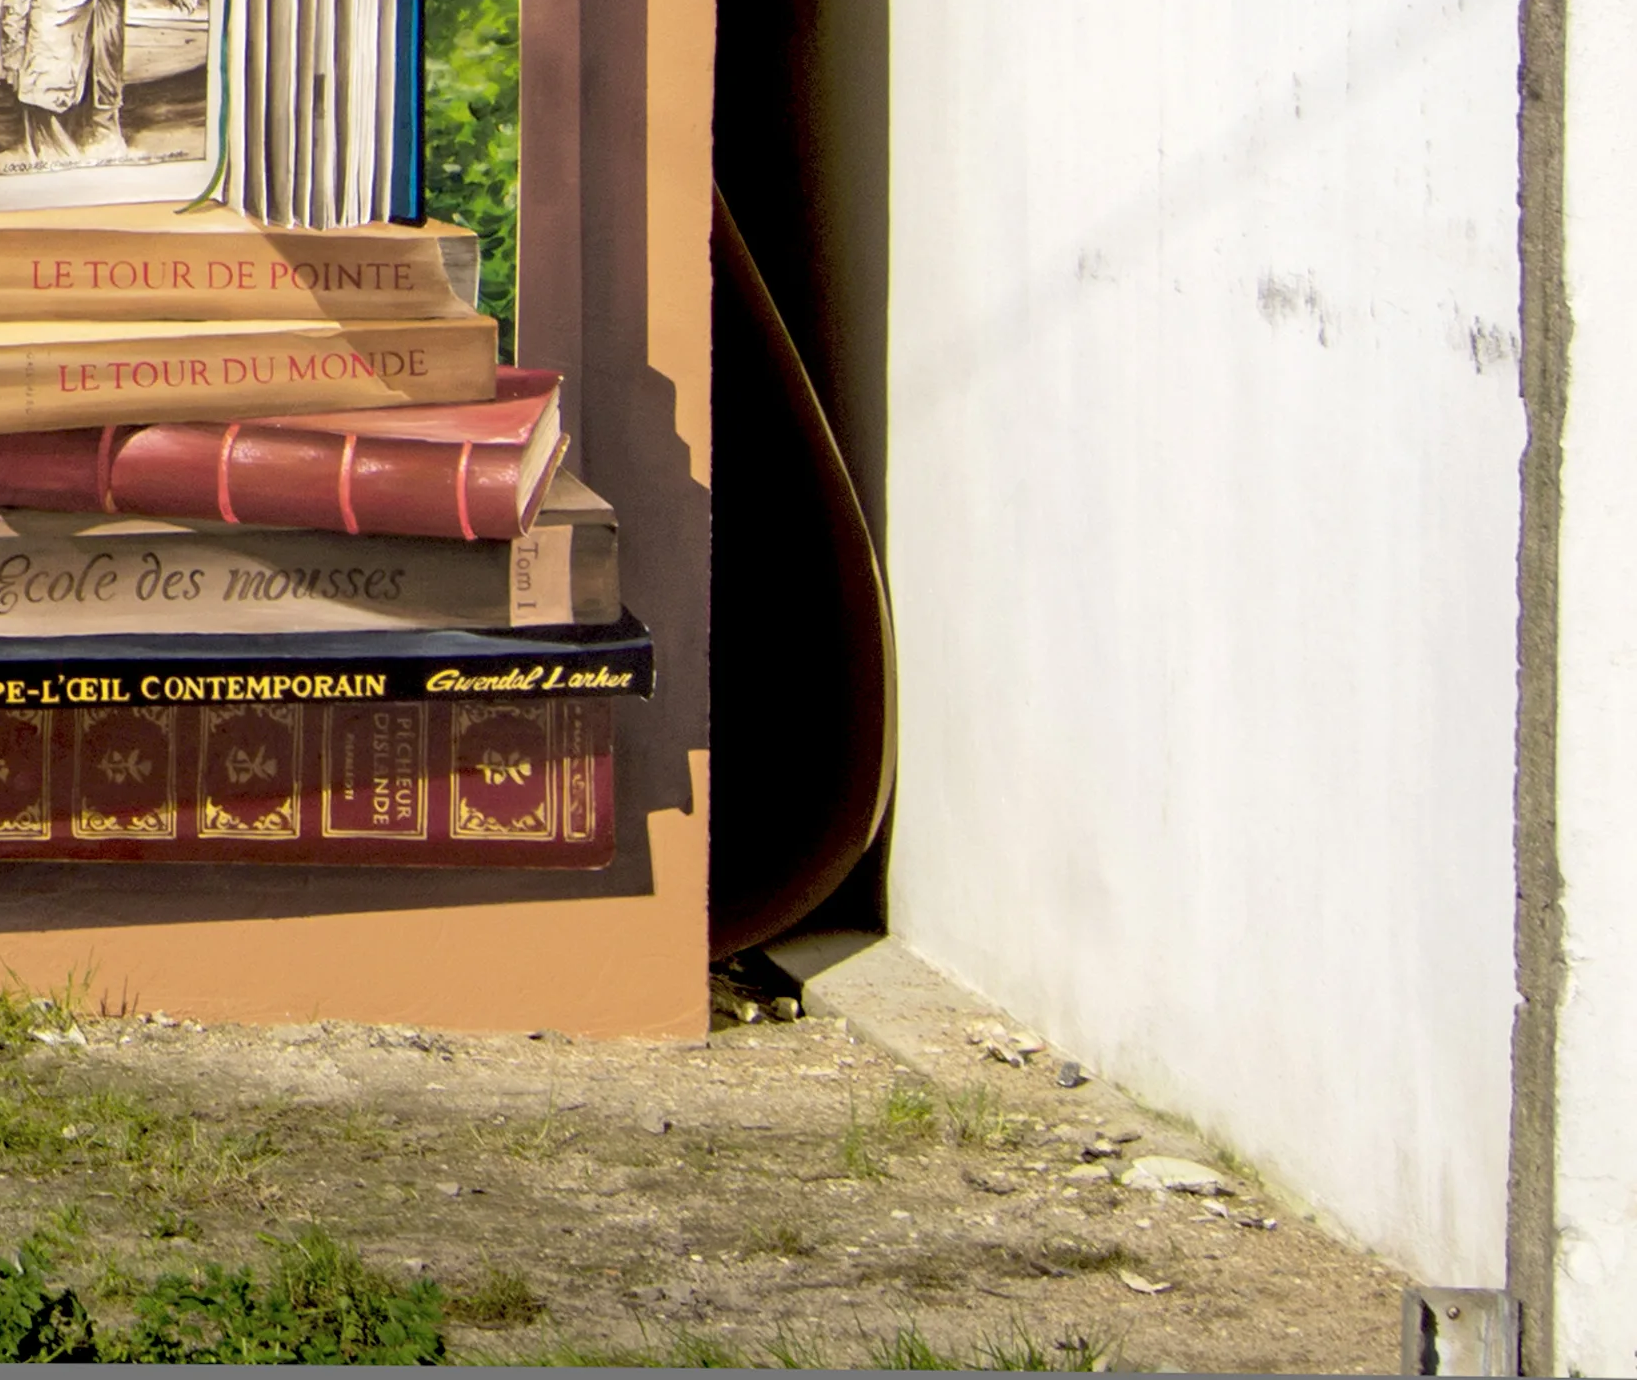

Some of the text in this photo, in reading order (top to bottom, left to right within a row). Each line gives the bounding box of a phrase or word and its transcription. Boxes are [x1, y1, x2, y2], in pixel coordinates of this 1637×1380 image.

[31, 260, 415, 292] LE TOUR DE POINTE
[58, 363, 100, 393] LE
[107, 359, 212, 389] TOUR
[221, 355, 275, 386] DU
[287, 348, 429, 383] MONDE
[135, 551, 206, 602] des
[223, 563, 407, 603] mousses
[516, 541, 540, 592] Tom
[140, 674, 387, 701] CONTEMPORAIN
[426, 665, 543, 693] Gwendal
